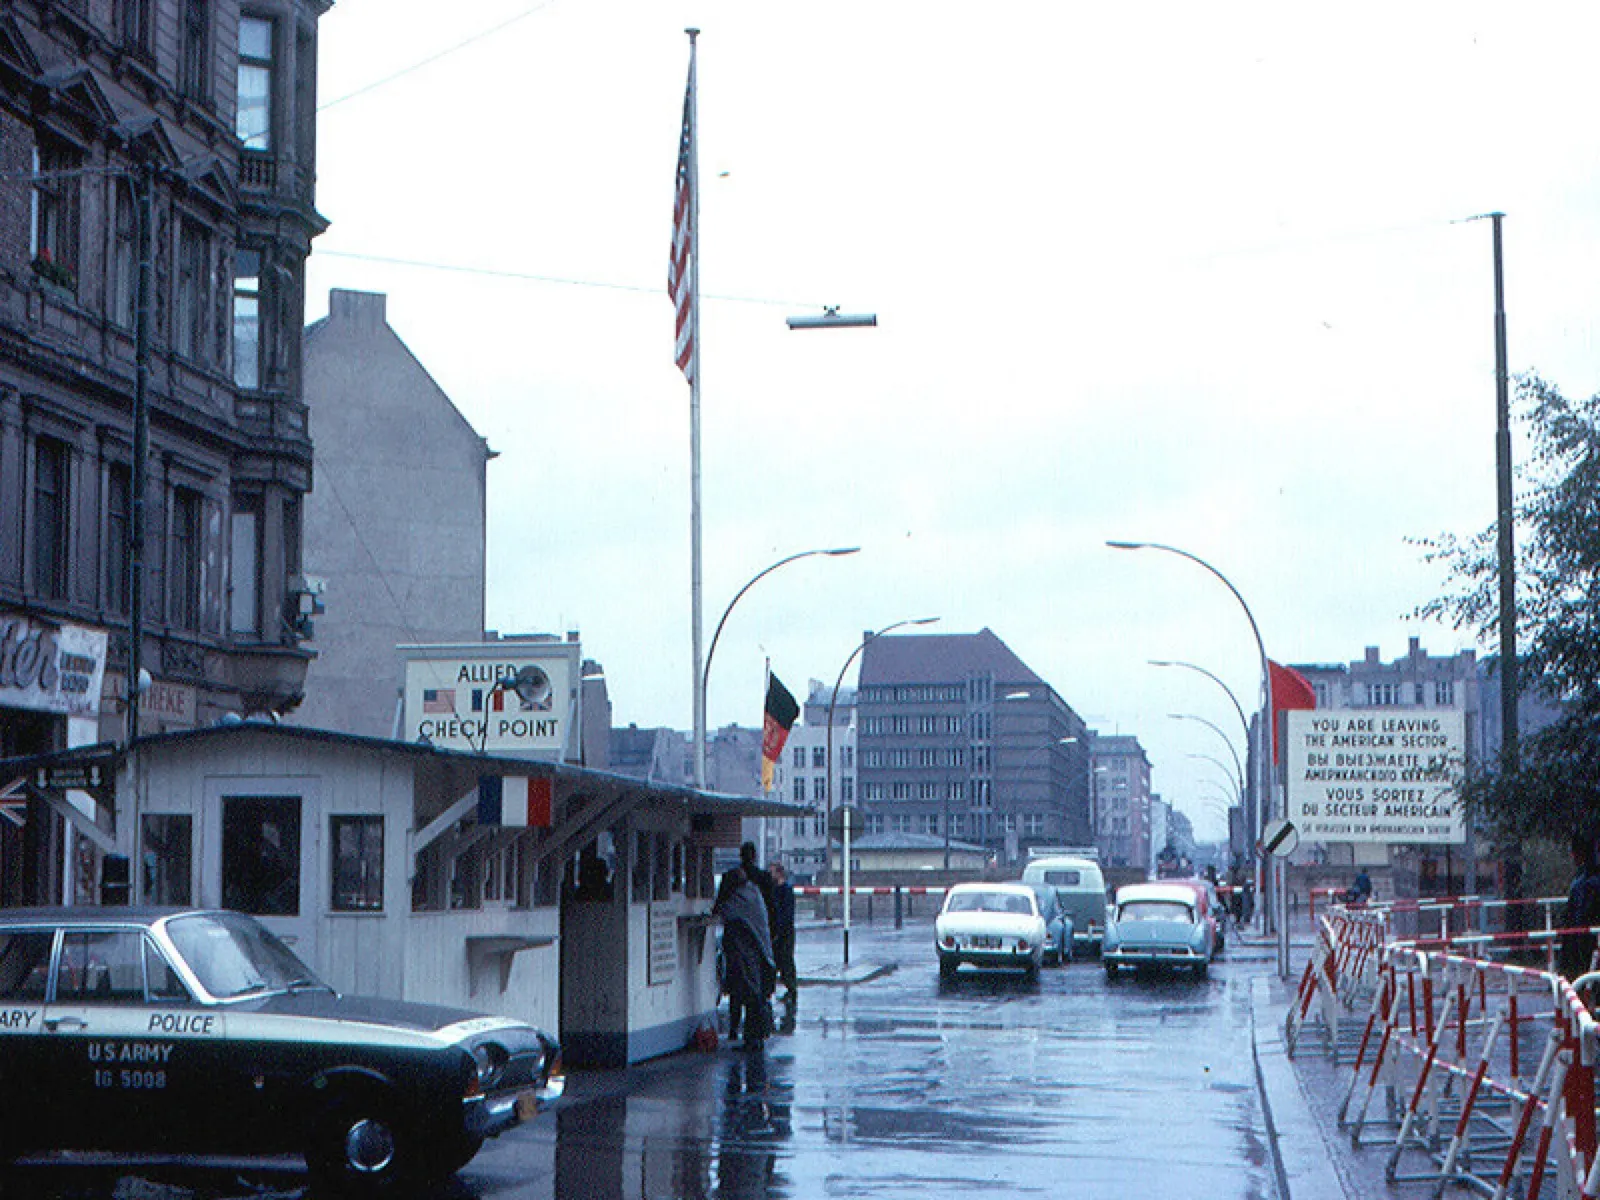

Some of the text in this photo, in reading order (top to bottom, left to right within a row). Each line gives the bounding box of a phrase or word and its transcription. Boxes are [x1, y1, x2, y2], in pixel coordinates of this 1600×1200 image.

[458, 664, 517, 682] ALLIED
[419, 720, 558, 737] CHECK POINT
[1312, 719, 1441, 732] YOU ARE LEAVING
[1305, 734, 1448, 747] THE AMERICAN SECTOR
[1325, 787, 1425, 801] VOUS SORTEZ
[1302, 804, 1318, 817] DU
[1326, 804, 1378, 817] SECTEUR
[148, 1014, 214, 1033] POLICE
[119, 1043, 173, 1062] ARMY
